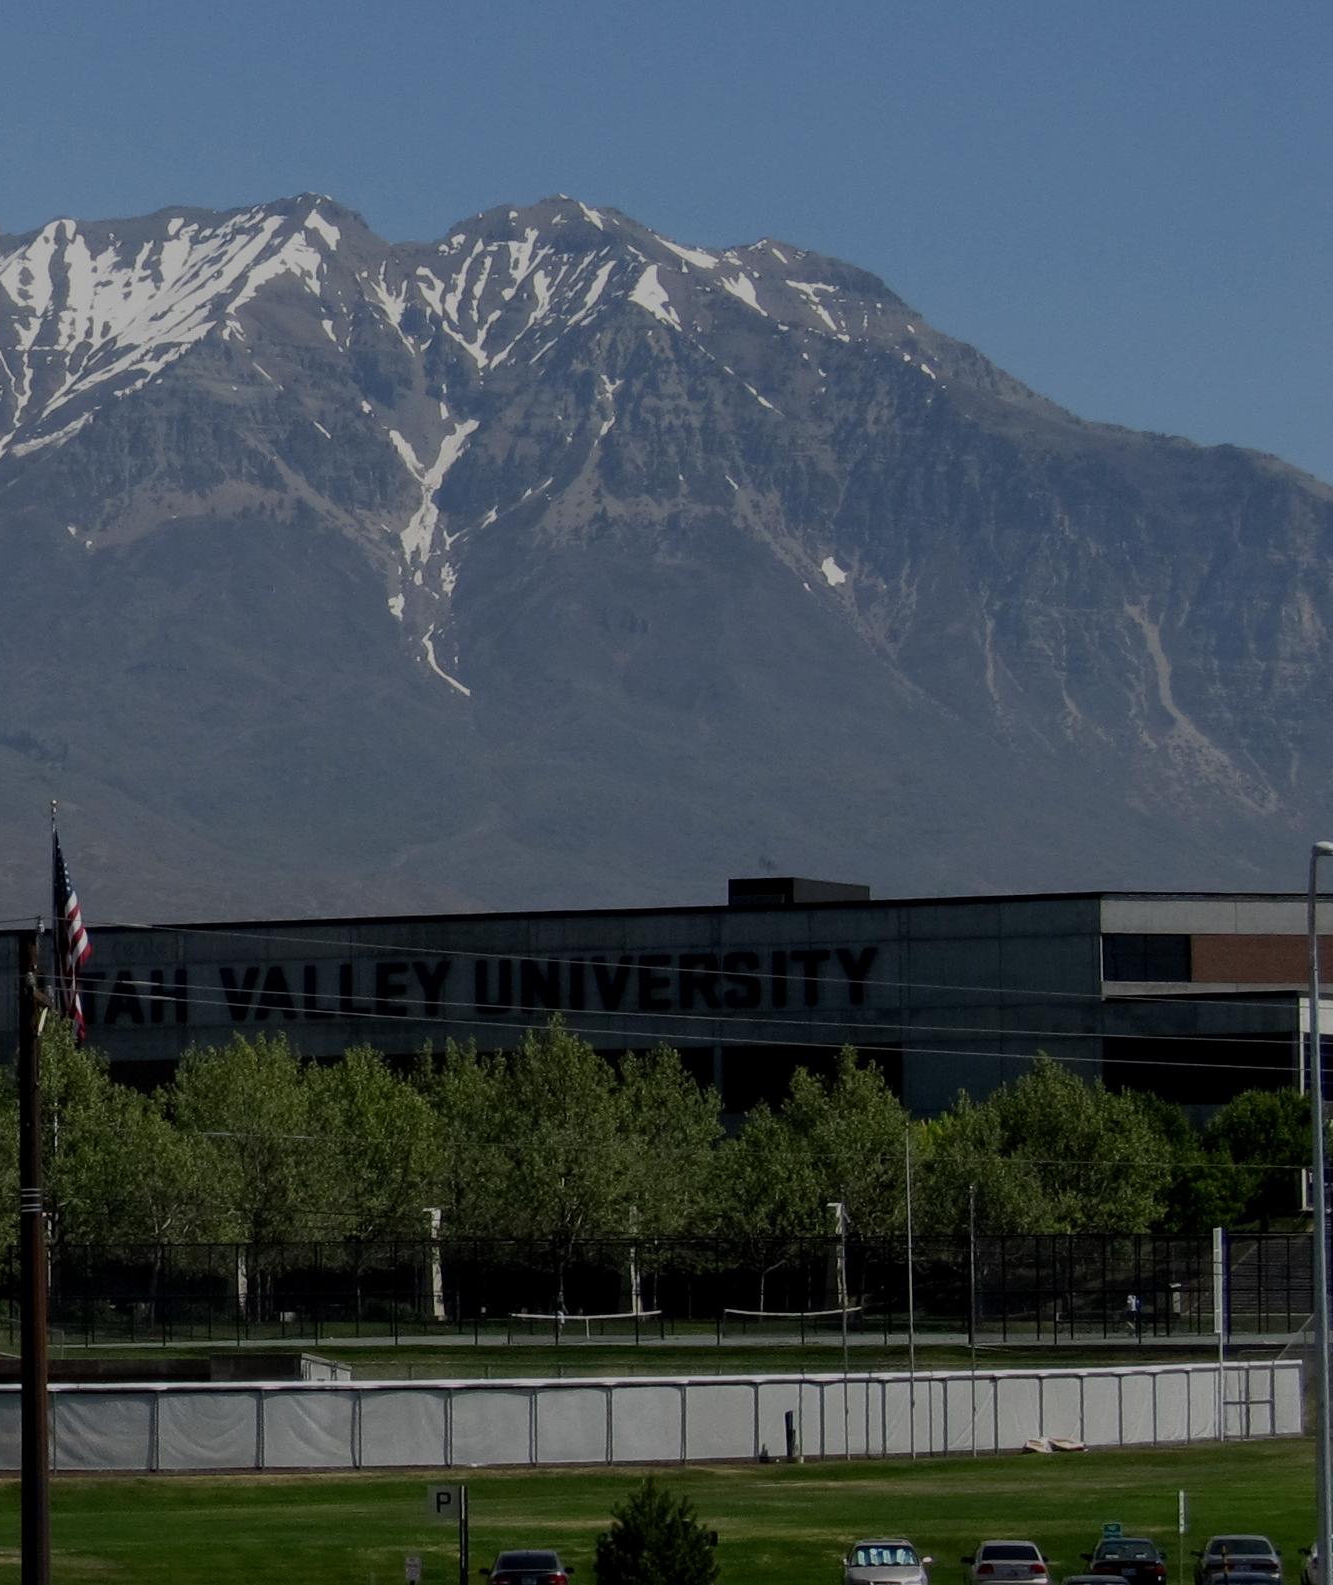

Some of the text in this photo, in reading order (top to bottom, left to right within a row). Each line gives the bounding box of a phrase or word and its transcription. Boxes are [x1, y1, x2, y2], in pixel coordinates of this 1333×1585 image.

[35, 946, 878, 1025] TAH VALLEY UNIVERSITY
[436, 1491, 452, 1513] P
